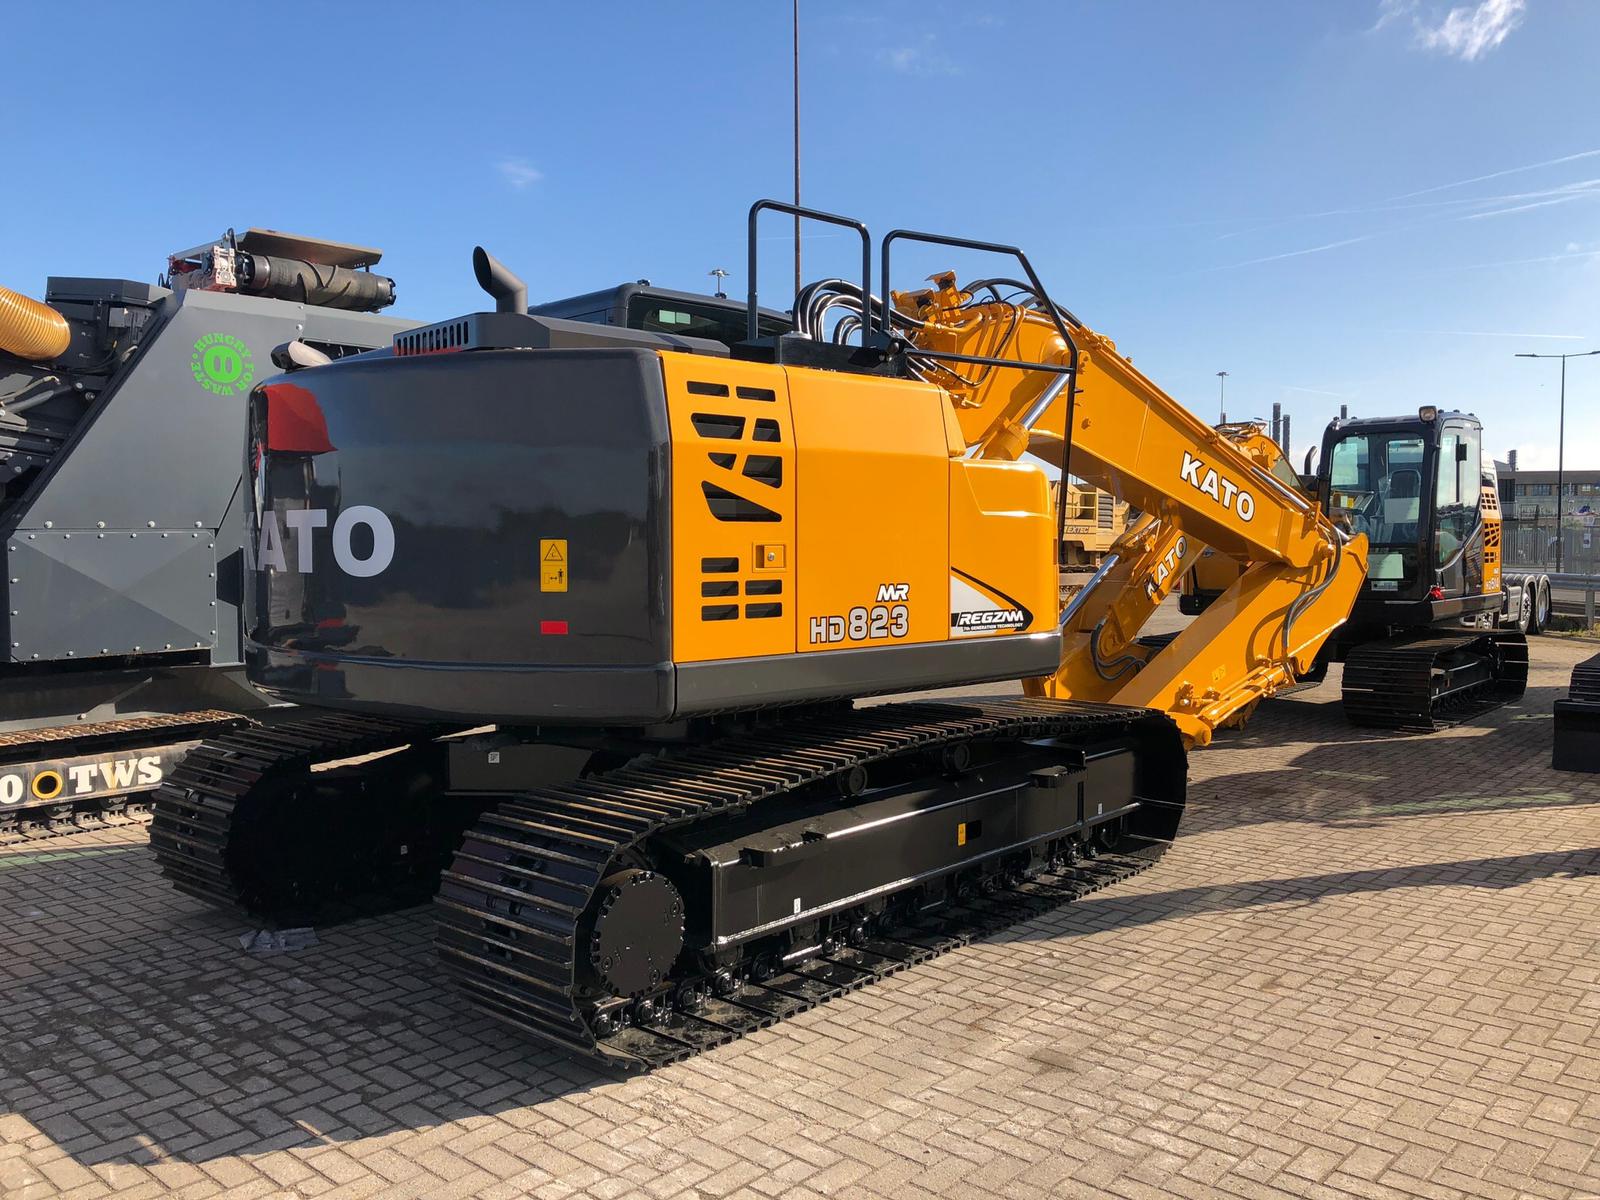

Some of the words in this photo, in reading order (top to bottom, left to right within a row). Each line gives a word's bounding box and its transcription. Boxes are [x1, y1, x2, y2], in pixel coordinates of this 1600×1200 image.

[194, 333, 252, 359] HUNGRY
[191, 362, 234, 396] WASTE
[236, 362, 255, 391] FOR
[1180, 450, 1255, 522] KATO
[1066, 525, 1089, 534] EXTEC
[1144, 536, 1187, 601] KATO
[875, 583, 910, 602] MR
[809, 605, 909, 644] HD823
[958, 610, 1024, 626] REGZAM
[68, 756, 163, 794] TWS
